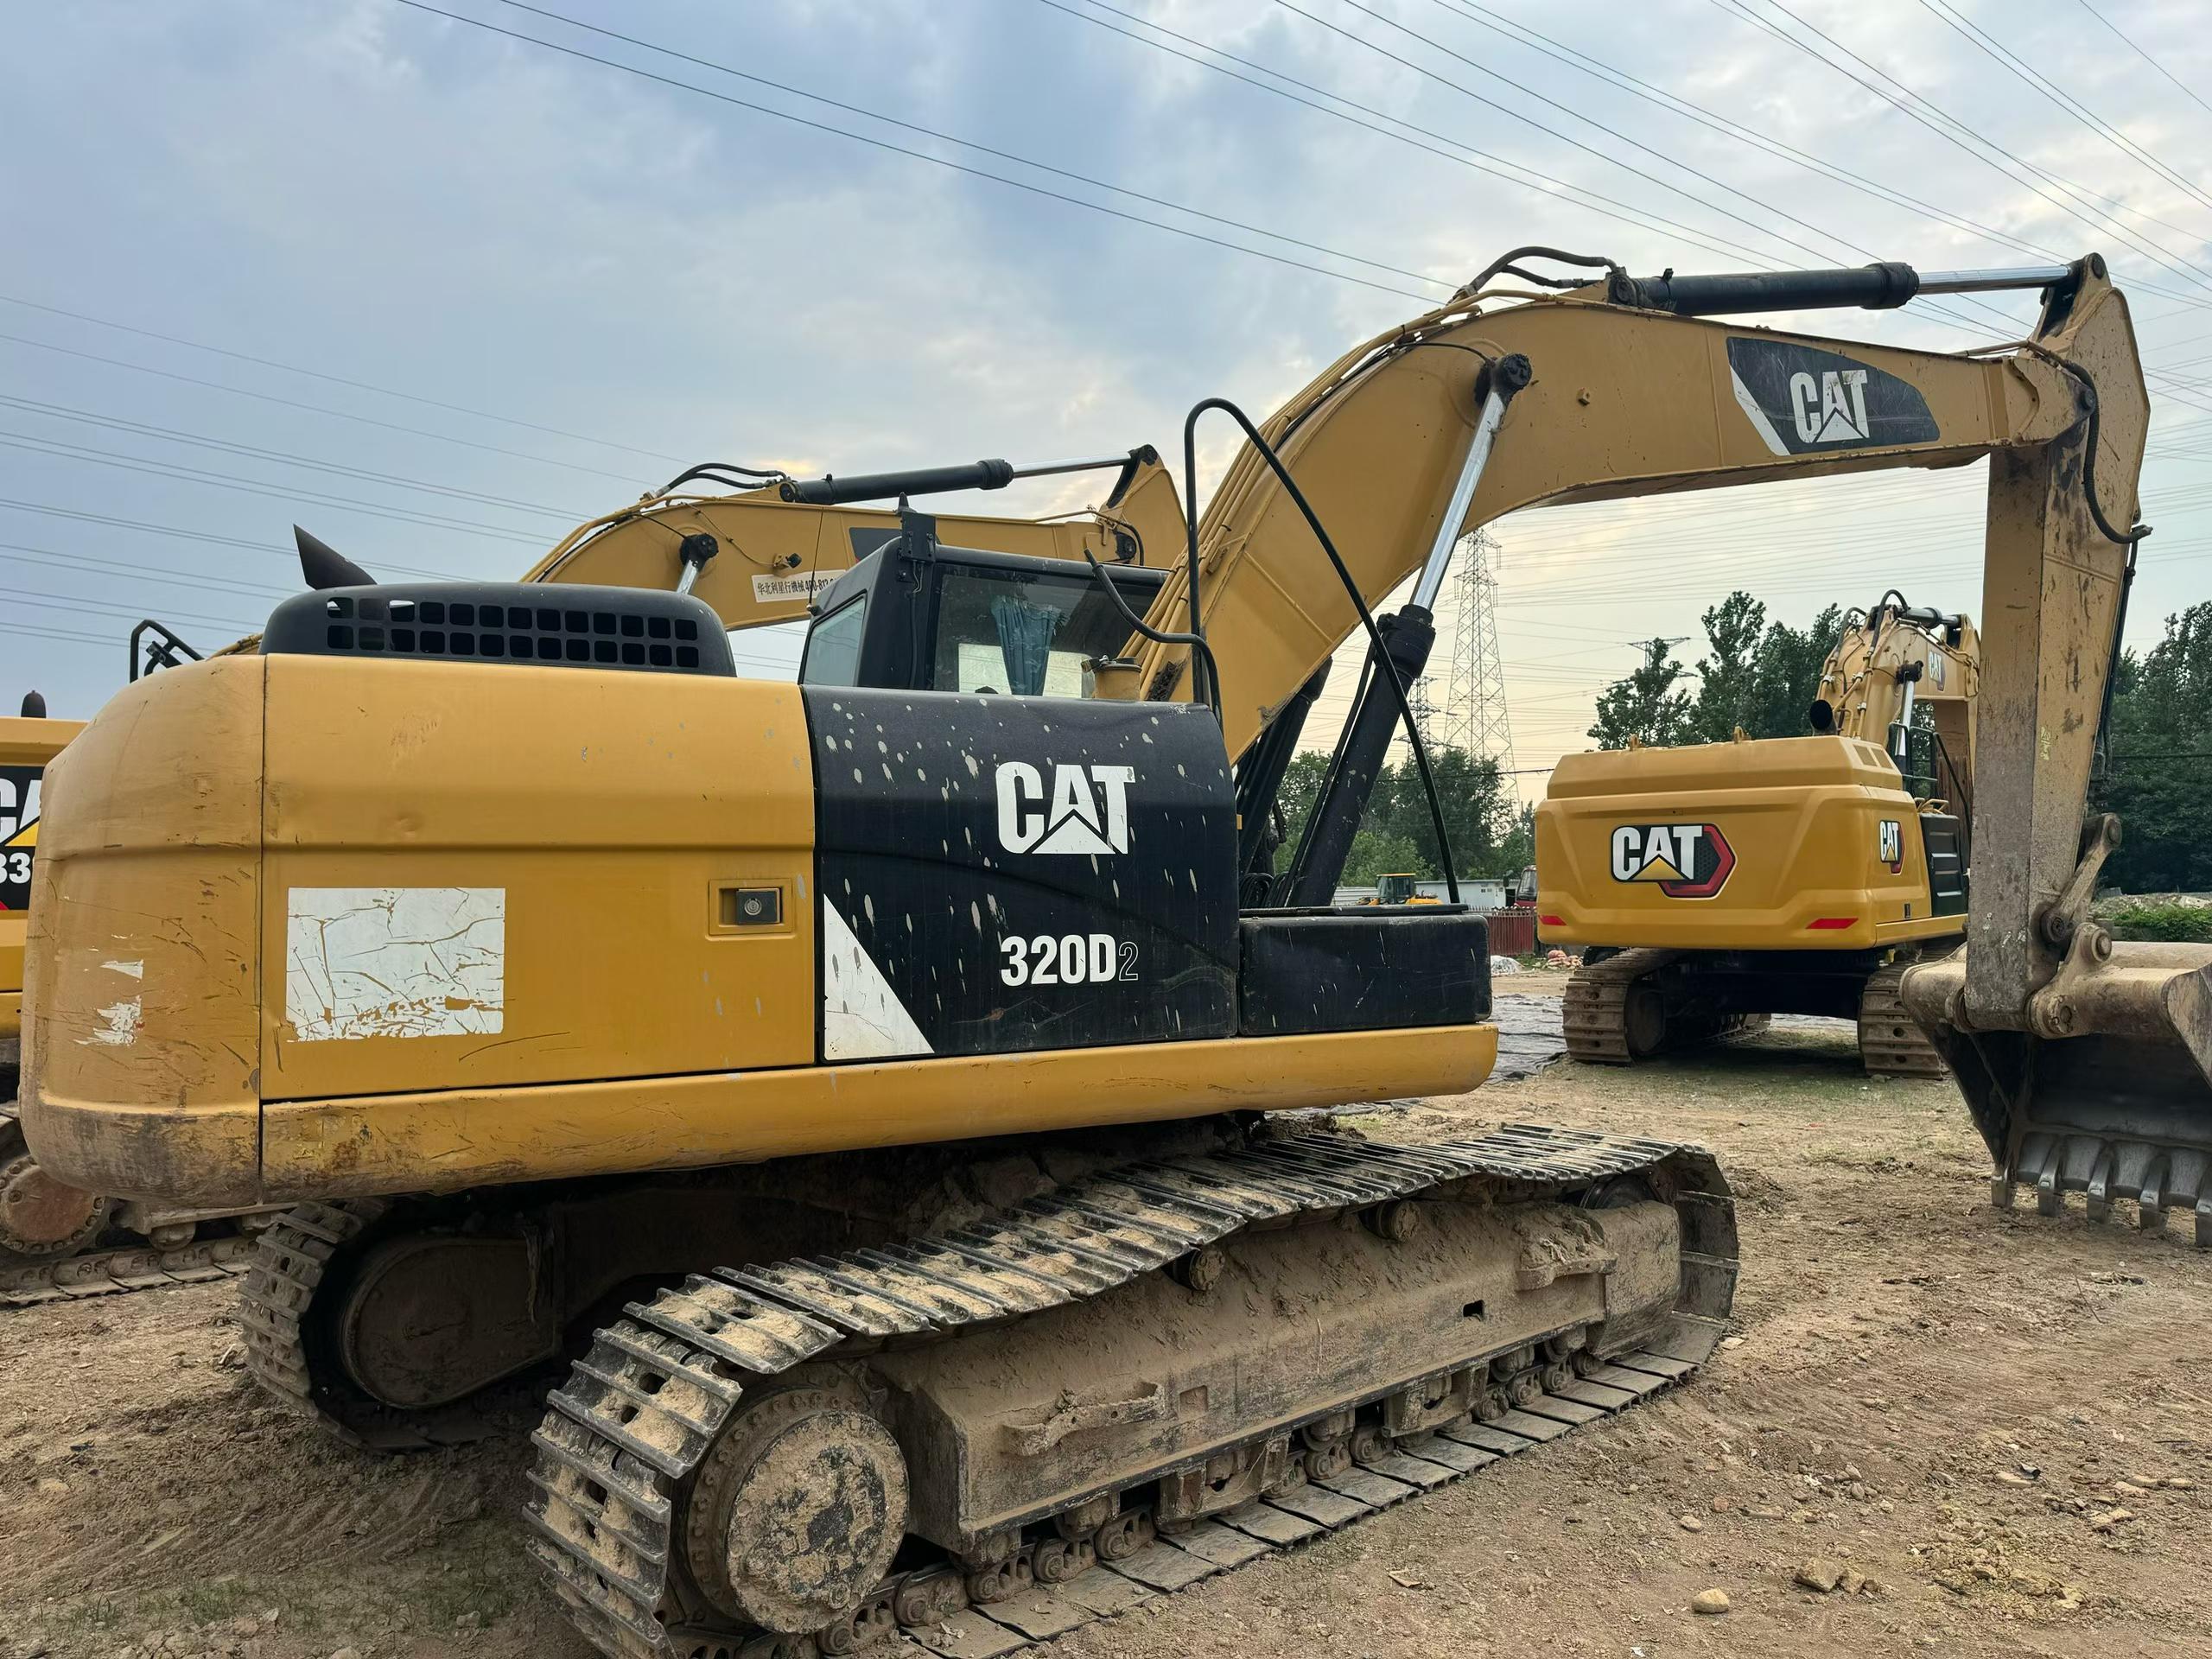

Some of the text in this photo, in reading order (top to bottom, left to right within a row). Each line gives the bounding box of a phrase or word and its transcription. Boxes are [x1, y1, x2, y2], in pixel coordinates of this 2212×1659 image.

[1790, 370, 1870, 443] CAT
[1929, 651, 1942, 683] CAT
[995, 761, 1135, 855] CAT
[1612, 825, 1702, 880] CAT
[1879, 821, 1899, 861] CAT
